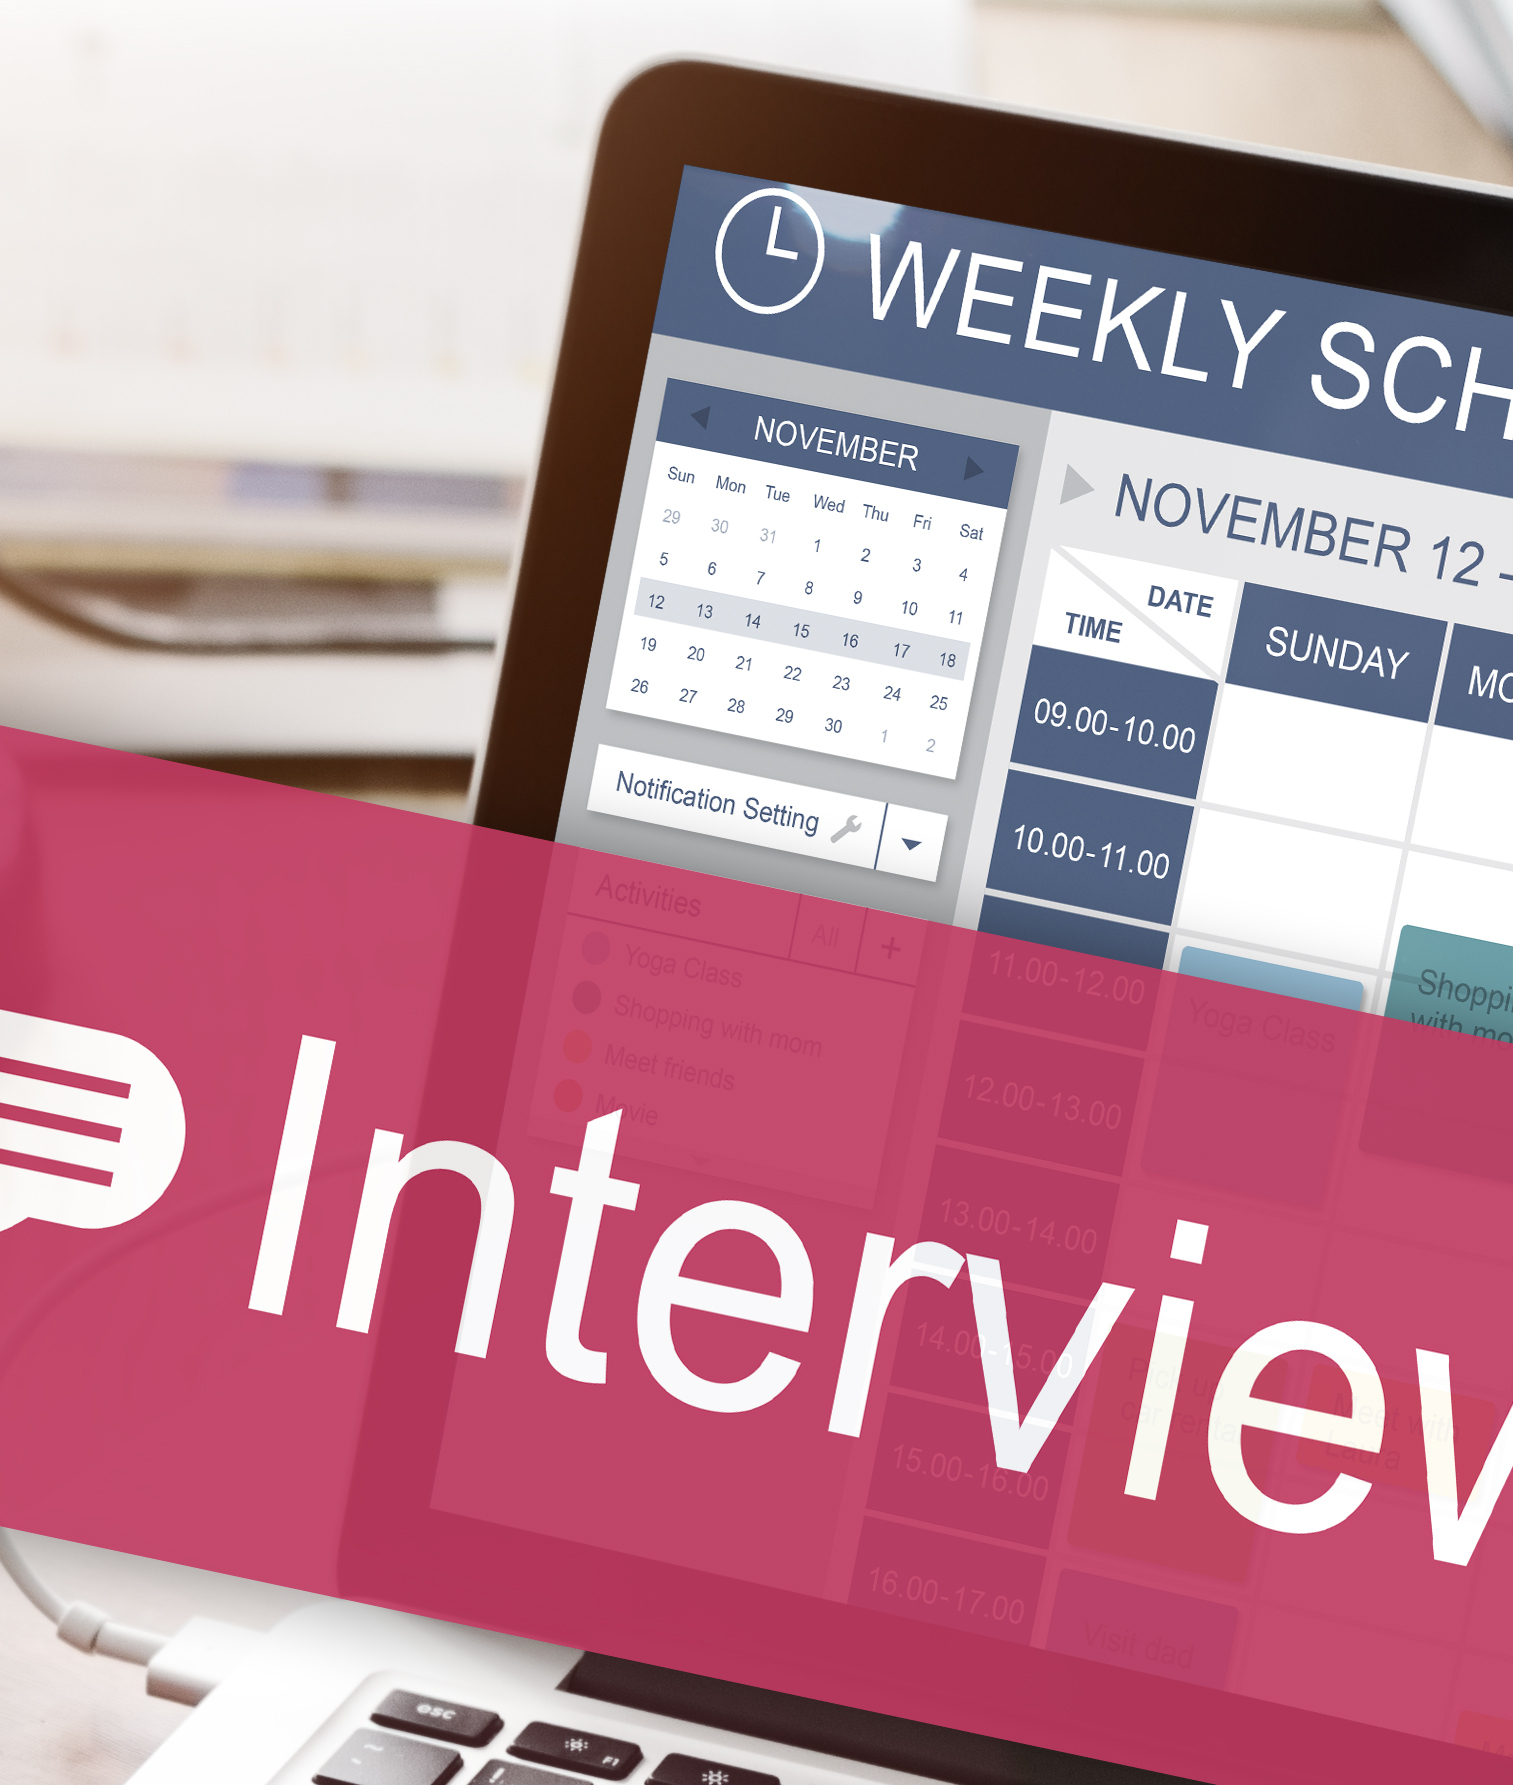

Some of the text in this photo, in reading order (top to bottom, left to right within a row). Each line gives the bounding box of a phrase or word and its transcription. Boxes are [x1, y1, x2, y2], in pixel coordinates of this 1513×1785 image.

[867, 232, 1287, 389] WEEKLY
[755, 416, 918, 471] NOVEMBER
[668, 466, 983, 540] Sun Mon Tue Wed Thu Fri Sat
[1115, 474, 1410, 572] NOVEMBER
[1433, 536, 1484, 586] 12
[1499, 573, 1513, 581] -
[663, 509, 967, 581] 29 30 31 1 2 3 4
[660, 552, 962, 625] 5 6 7 8 9 10 11
[1148, 585, 1214, 617] DATE
[650, 594, 956, 667] 12 13 14 15 16 17 18
[1066, 612, 1122, 643] TIME
[1266, 626, 1409, 679] SUNDAY
[642, 637, 948, 710] 19 20 21 22 23 24 25
[631, 679, 935, 752] 26 27 28 29 30 1 2
[1035, 698, 1195, 753] 09.00-10.00
[617, 771, 819, 837] Notification Setting
[1015, 825, 1169, 879] 10.00-11.00
[595, 874, 839, 948] Activities All
[626, 944, 742, 988] Yoga Class
[988, 949, 1146, 1004] 11.00-12.00
[615, 995, 822, 1058] Shopping with mom
[1190, 998, 1335, 1052] Yoga Class
[605, 1044, 734, 1090] Meet friends
[966, 1074, 1121, 1129] 12.00-13.00
[939, 1197, 1098, 1254] 13.00-14.00
[891, 1443, 1049, 1501] 15.00-16.00
[869, 1567, 1024, 1625] 16.00-17.00
[1085, 1620, 1195, 1669] Visit dad
[417, 1705, 455, 1719] esc
[602, 1756, 619, 1766] F1
